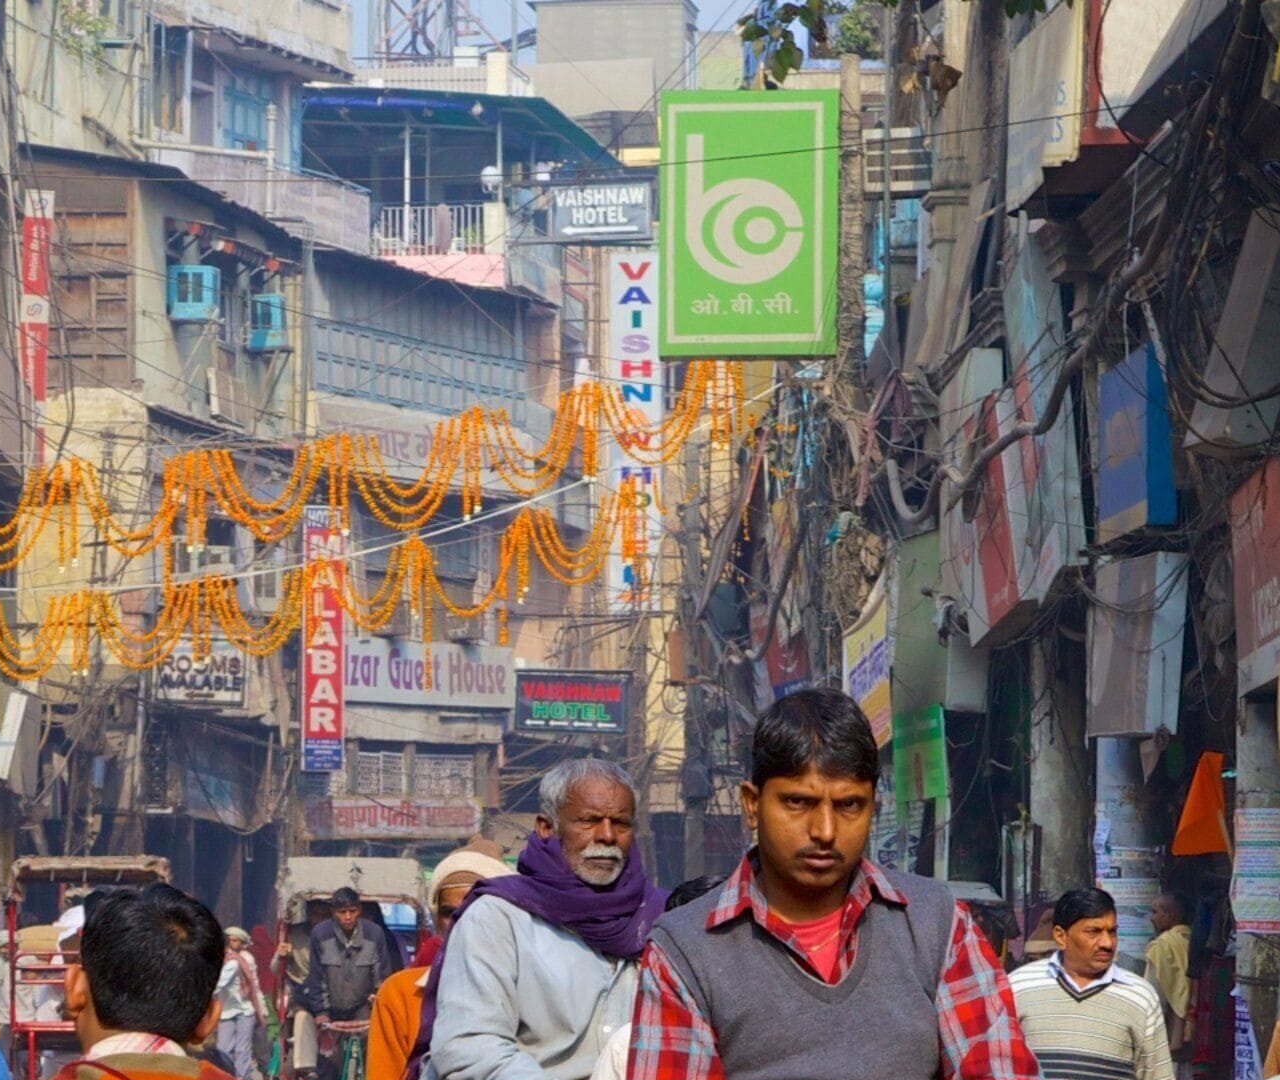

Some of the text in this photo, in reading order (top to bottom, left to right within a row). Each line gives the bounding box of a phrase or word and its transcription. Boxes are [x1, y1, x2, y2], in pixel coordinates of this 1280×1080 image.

[555, 186, 645, 207] VAISHNAW
[571, 206, 629, 225] HOTEL
[387, 648, 441, 691] Guet
[448, 652, 506, 696] House
[532, 702, 611, 720] HOTEL
